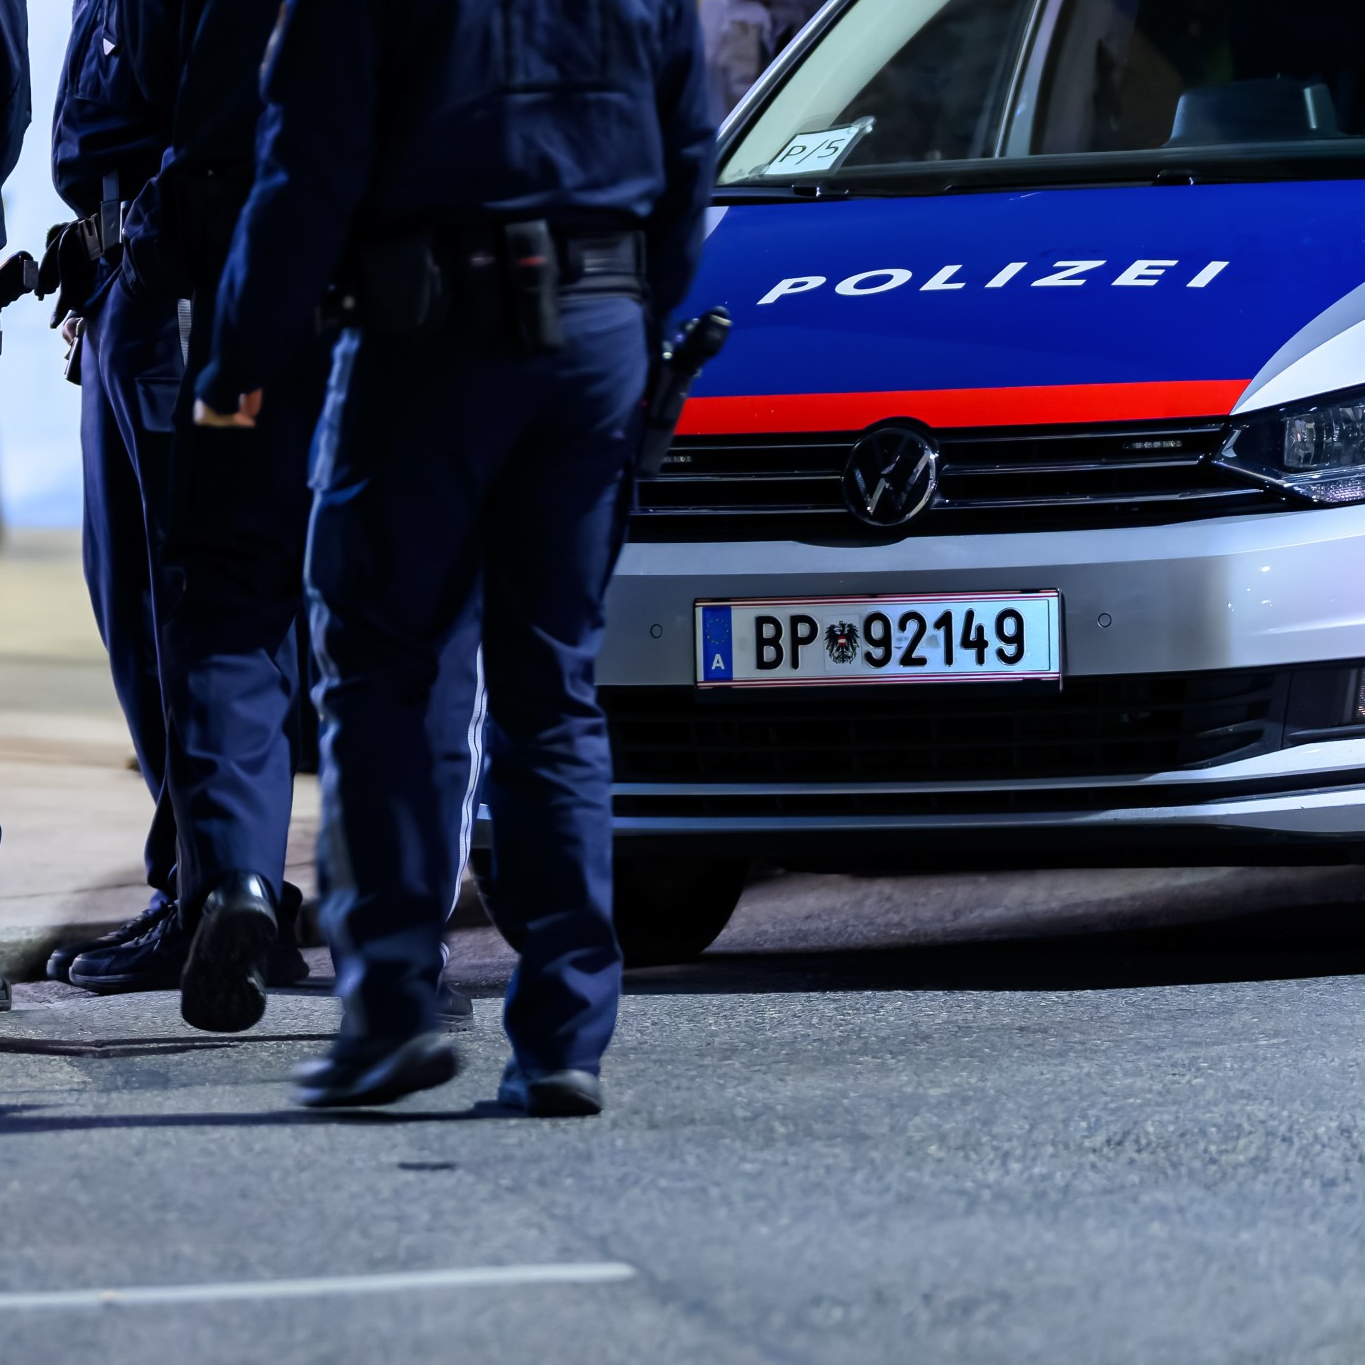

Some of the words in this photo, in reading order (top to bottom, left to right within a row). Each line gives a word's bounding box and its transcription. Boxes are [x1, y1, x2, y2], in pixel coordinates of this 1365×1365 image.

[777, 138, 846, 166] P/5
[755, 259, 1231, 306] POLIZEI
[754, 613, 820, 671] BP
[862, 608, 1027, 669] 92149
[710, 653, 726, 671] A
